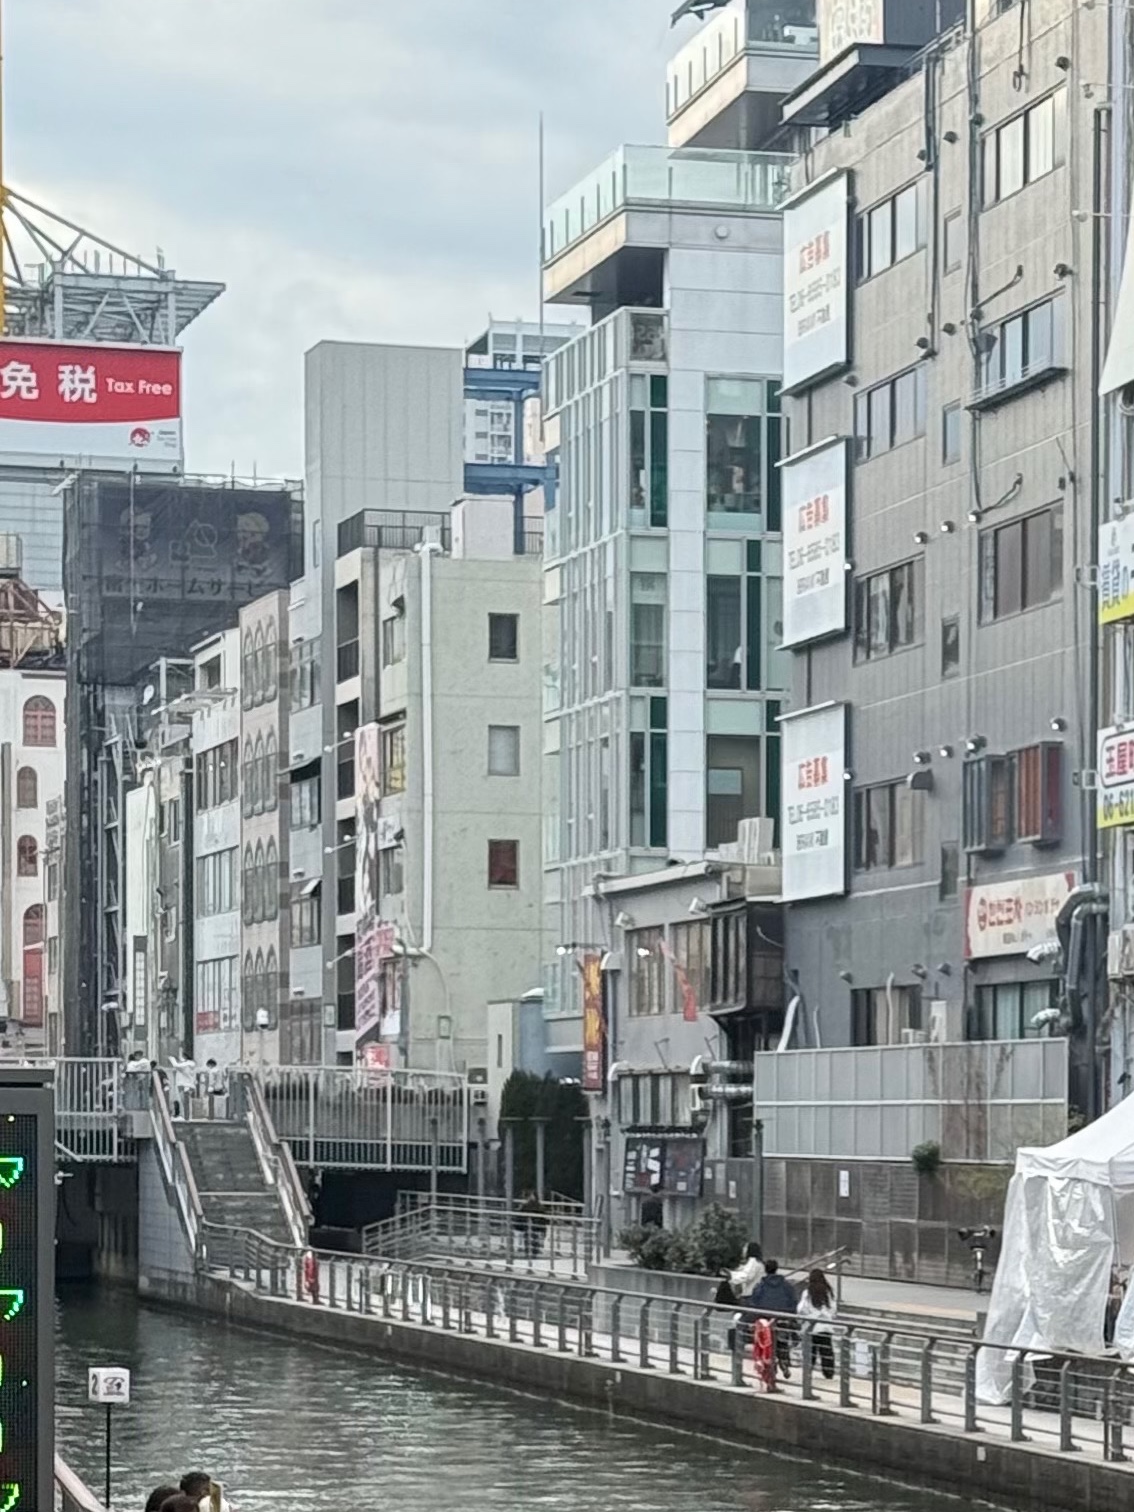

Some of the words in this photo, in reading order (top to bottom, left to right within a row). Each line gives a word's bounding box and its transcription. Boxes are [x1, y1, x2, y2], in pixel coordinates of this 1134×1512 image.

[0, 361, 98, 404] 免税
[105, 377, 136, 395] Tax
[138, 379, 173, 396] Free
